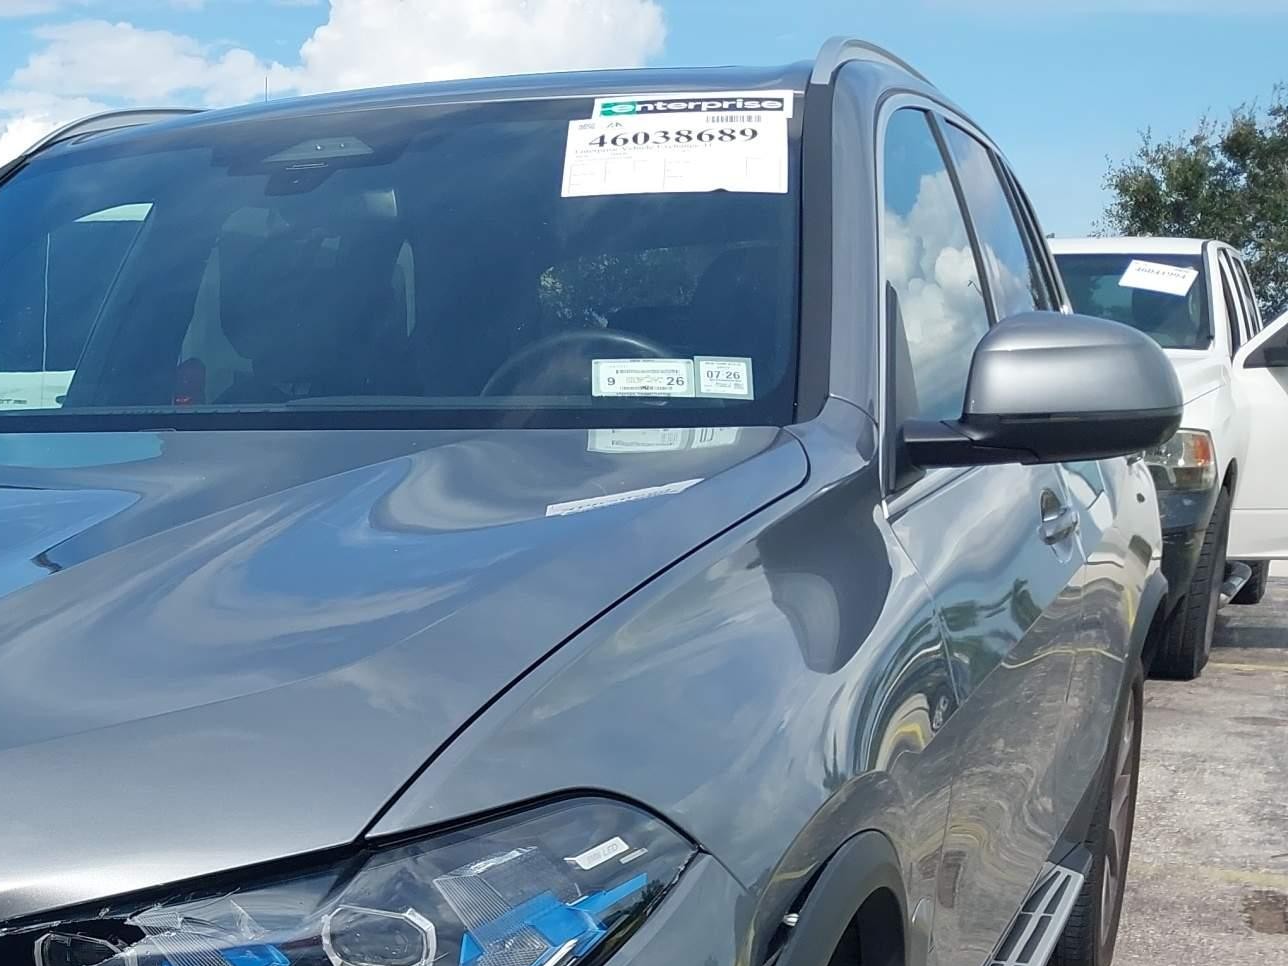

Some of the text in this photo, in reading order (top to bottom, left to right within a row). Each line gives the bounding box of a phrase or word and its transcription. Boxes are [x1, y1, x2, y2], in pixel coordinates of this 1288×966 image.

[611, 98, 783, 113] enterprise
[588, 128, 758, 147] 46038689
[706, 370, 741, 379] 07 26
[607, 376, 685, 386] 9 26
